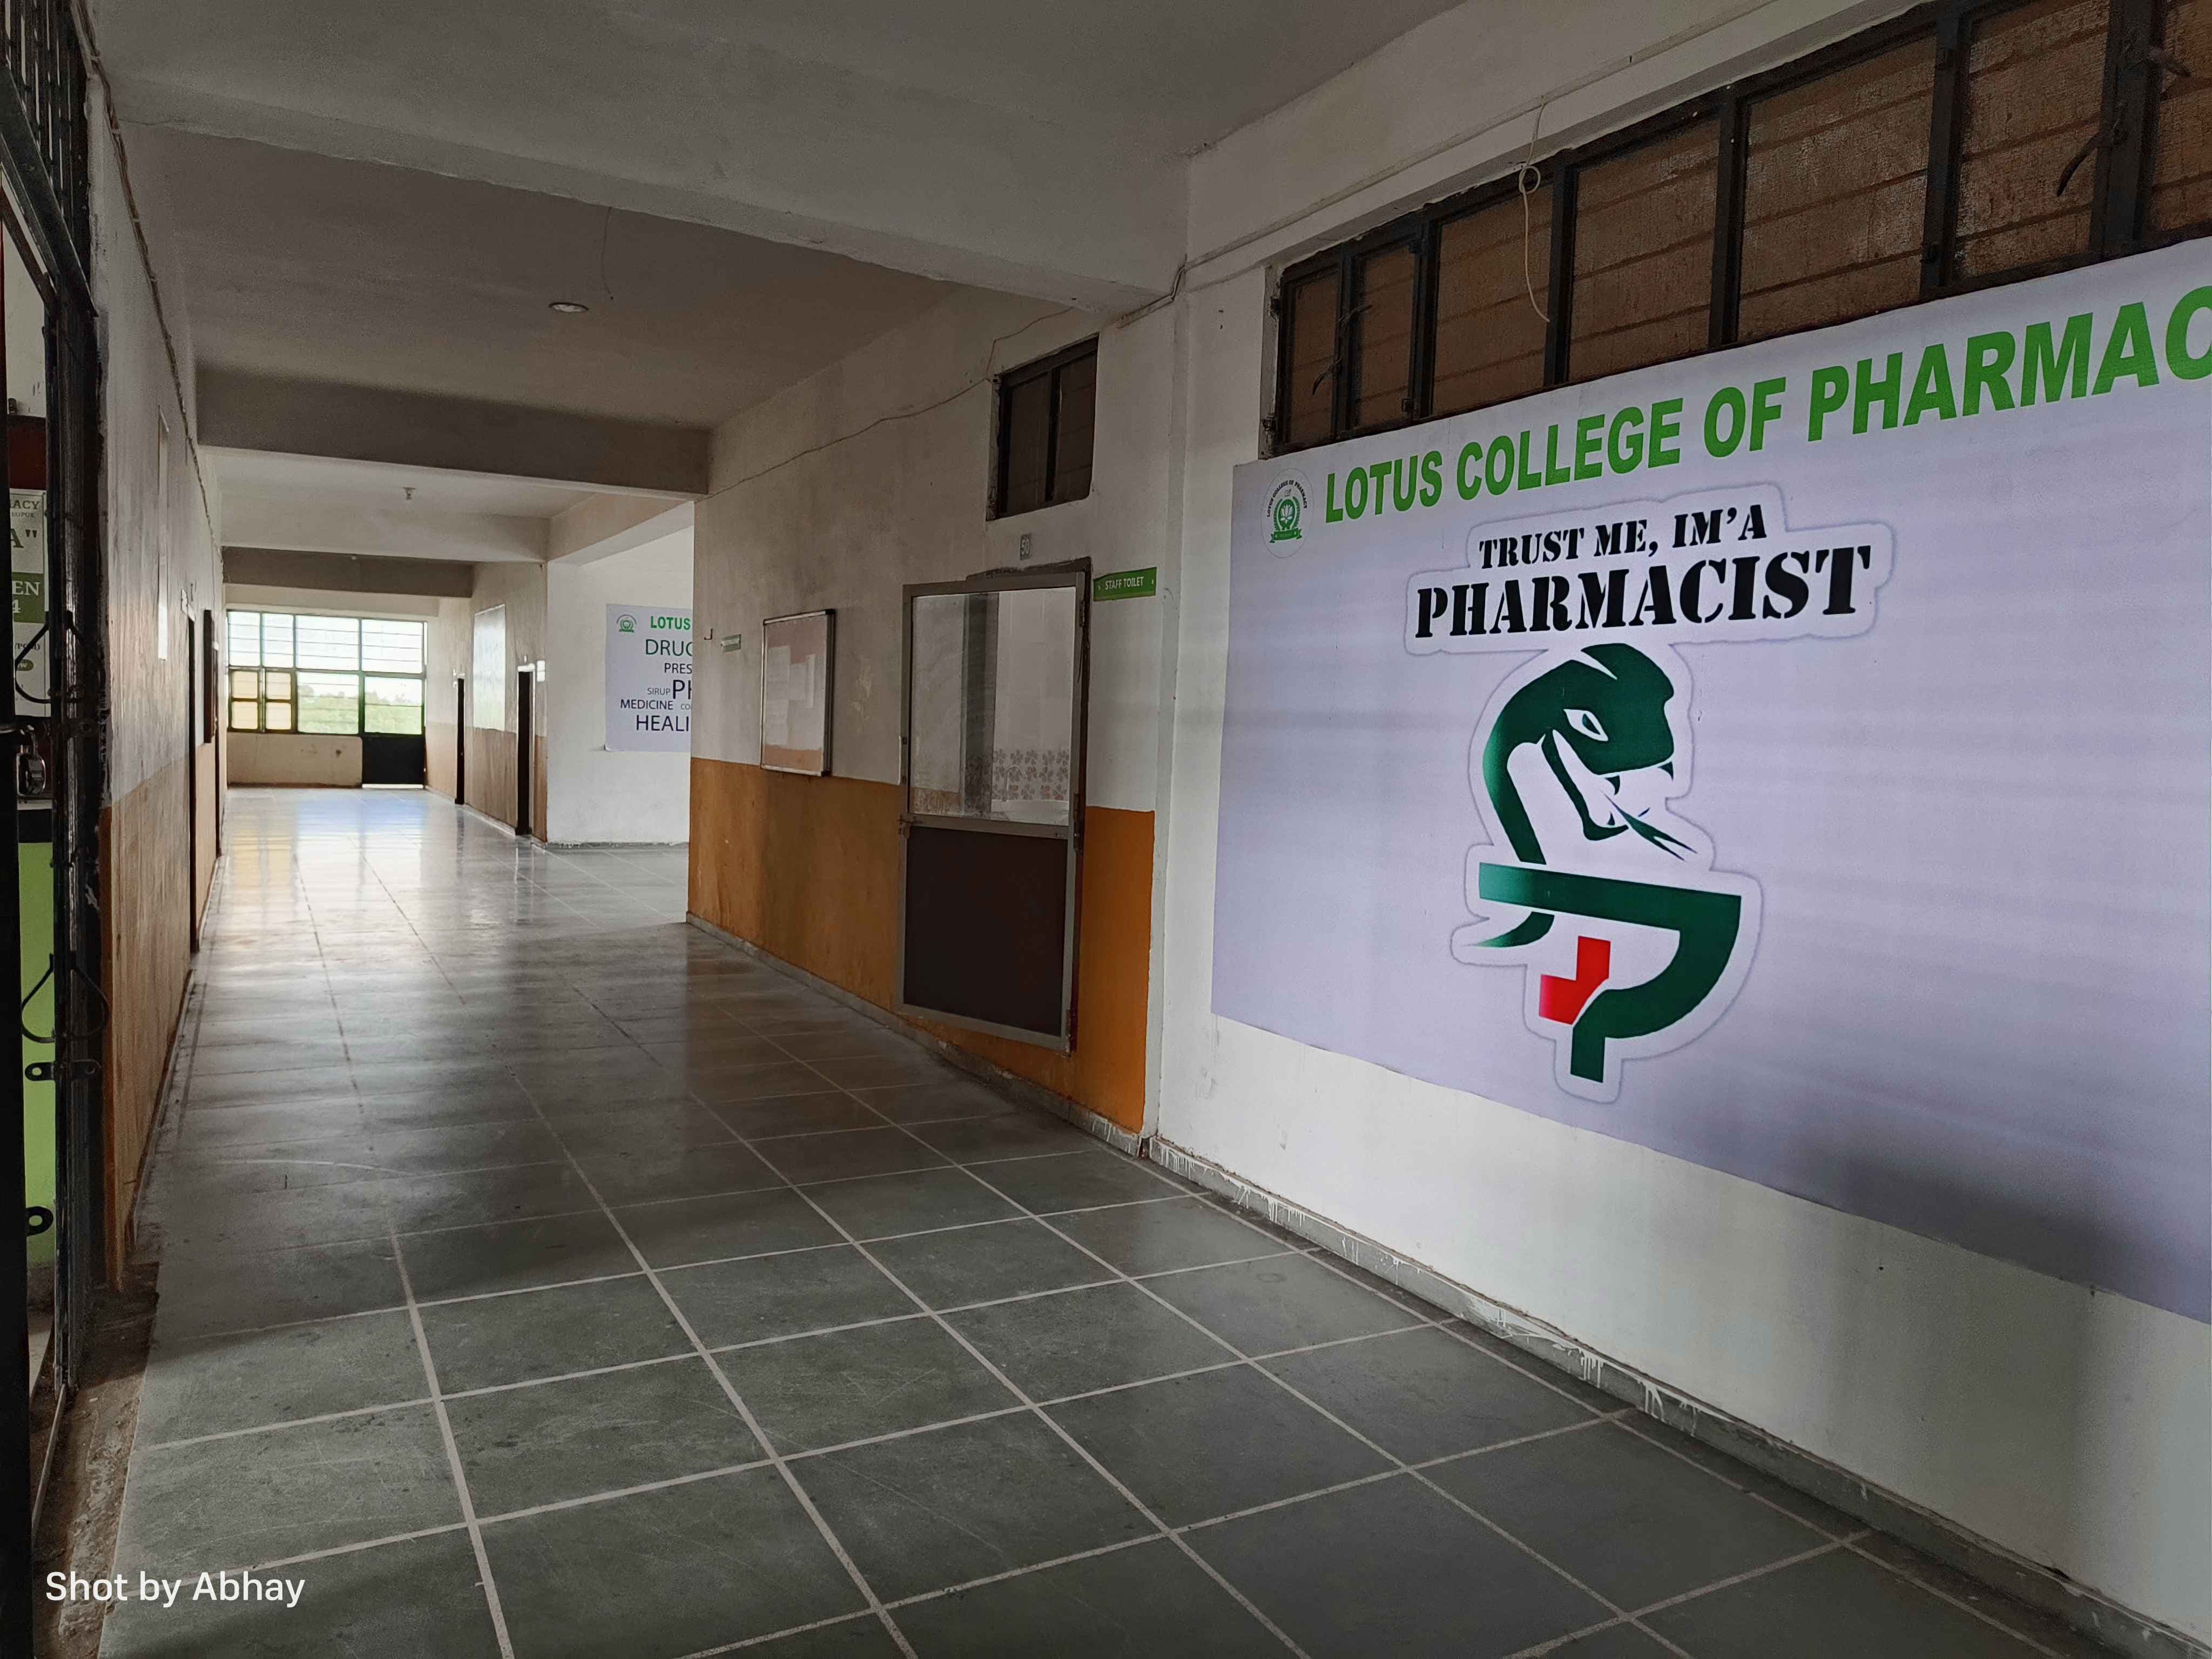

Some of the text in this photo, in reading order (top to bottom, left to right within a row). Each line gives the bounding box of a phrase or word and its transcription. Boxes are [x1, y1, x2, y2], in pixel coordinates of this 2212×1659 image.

[1326, 450, 1442, 523] LOTUS
[1456, 398, 1683, 501] COLLEGE
[1704, 376, 1786, 458] OF
[10, 500, 40, 509] ACY
[1021, 538, 1030, 555] 50
[1479, 527, 1586, 570] TRUST
[1594, 519, 1658, 557] ME,
[1105, 576, 1145, 590] STAFF TOILET
[1414, 544, 1871, 639] PHARMACIST
[650, 616, 691, 630] LOTUS
[664, 663, 692, 675] PRES
[647, 687, 671, 696] SIRUP
[620, 699, 673, 710] MEDICINE
